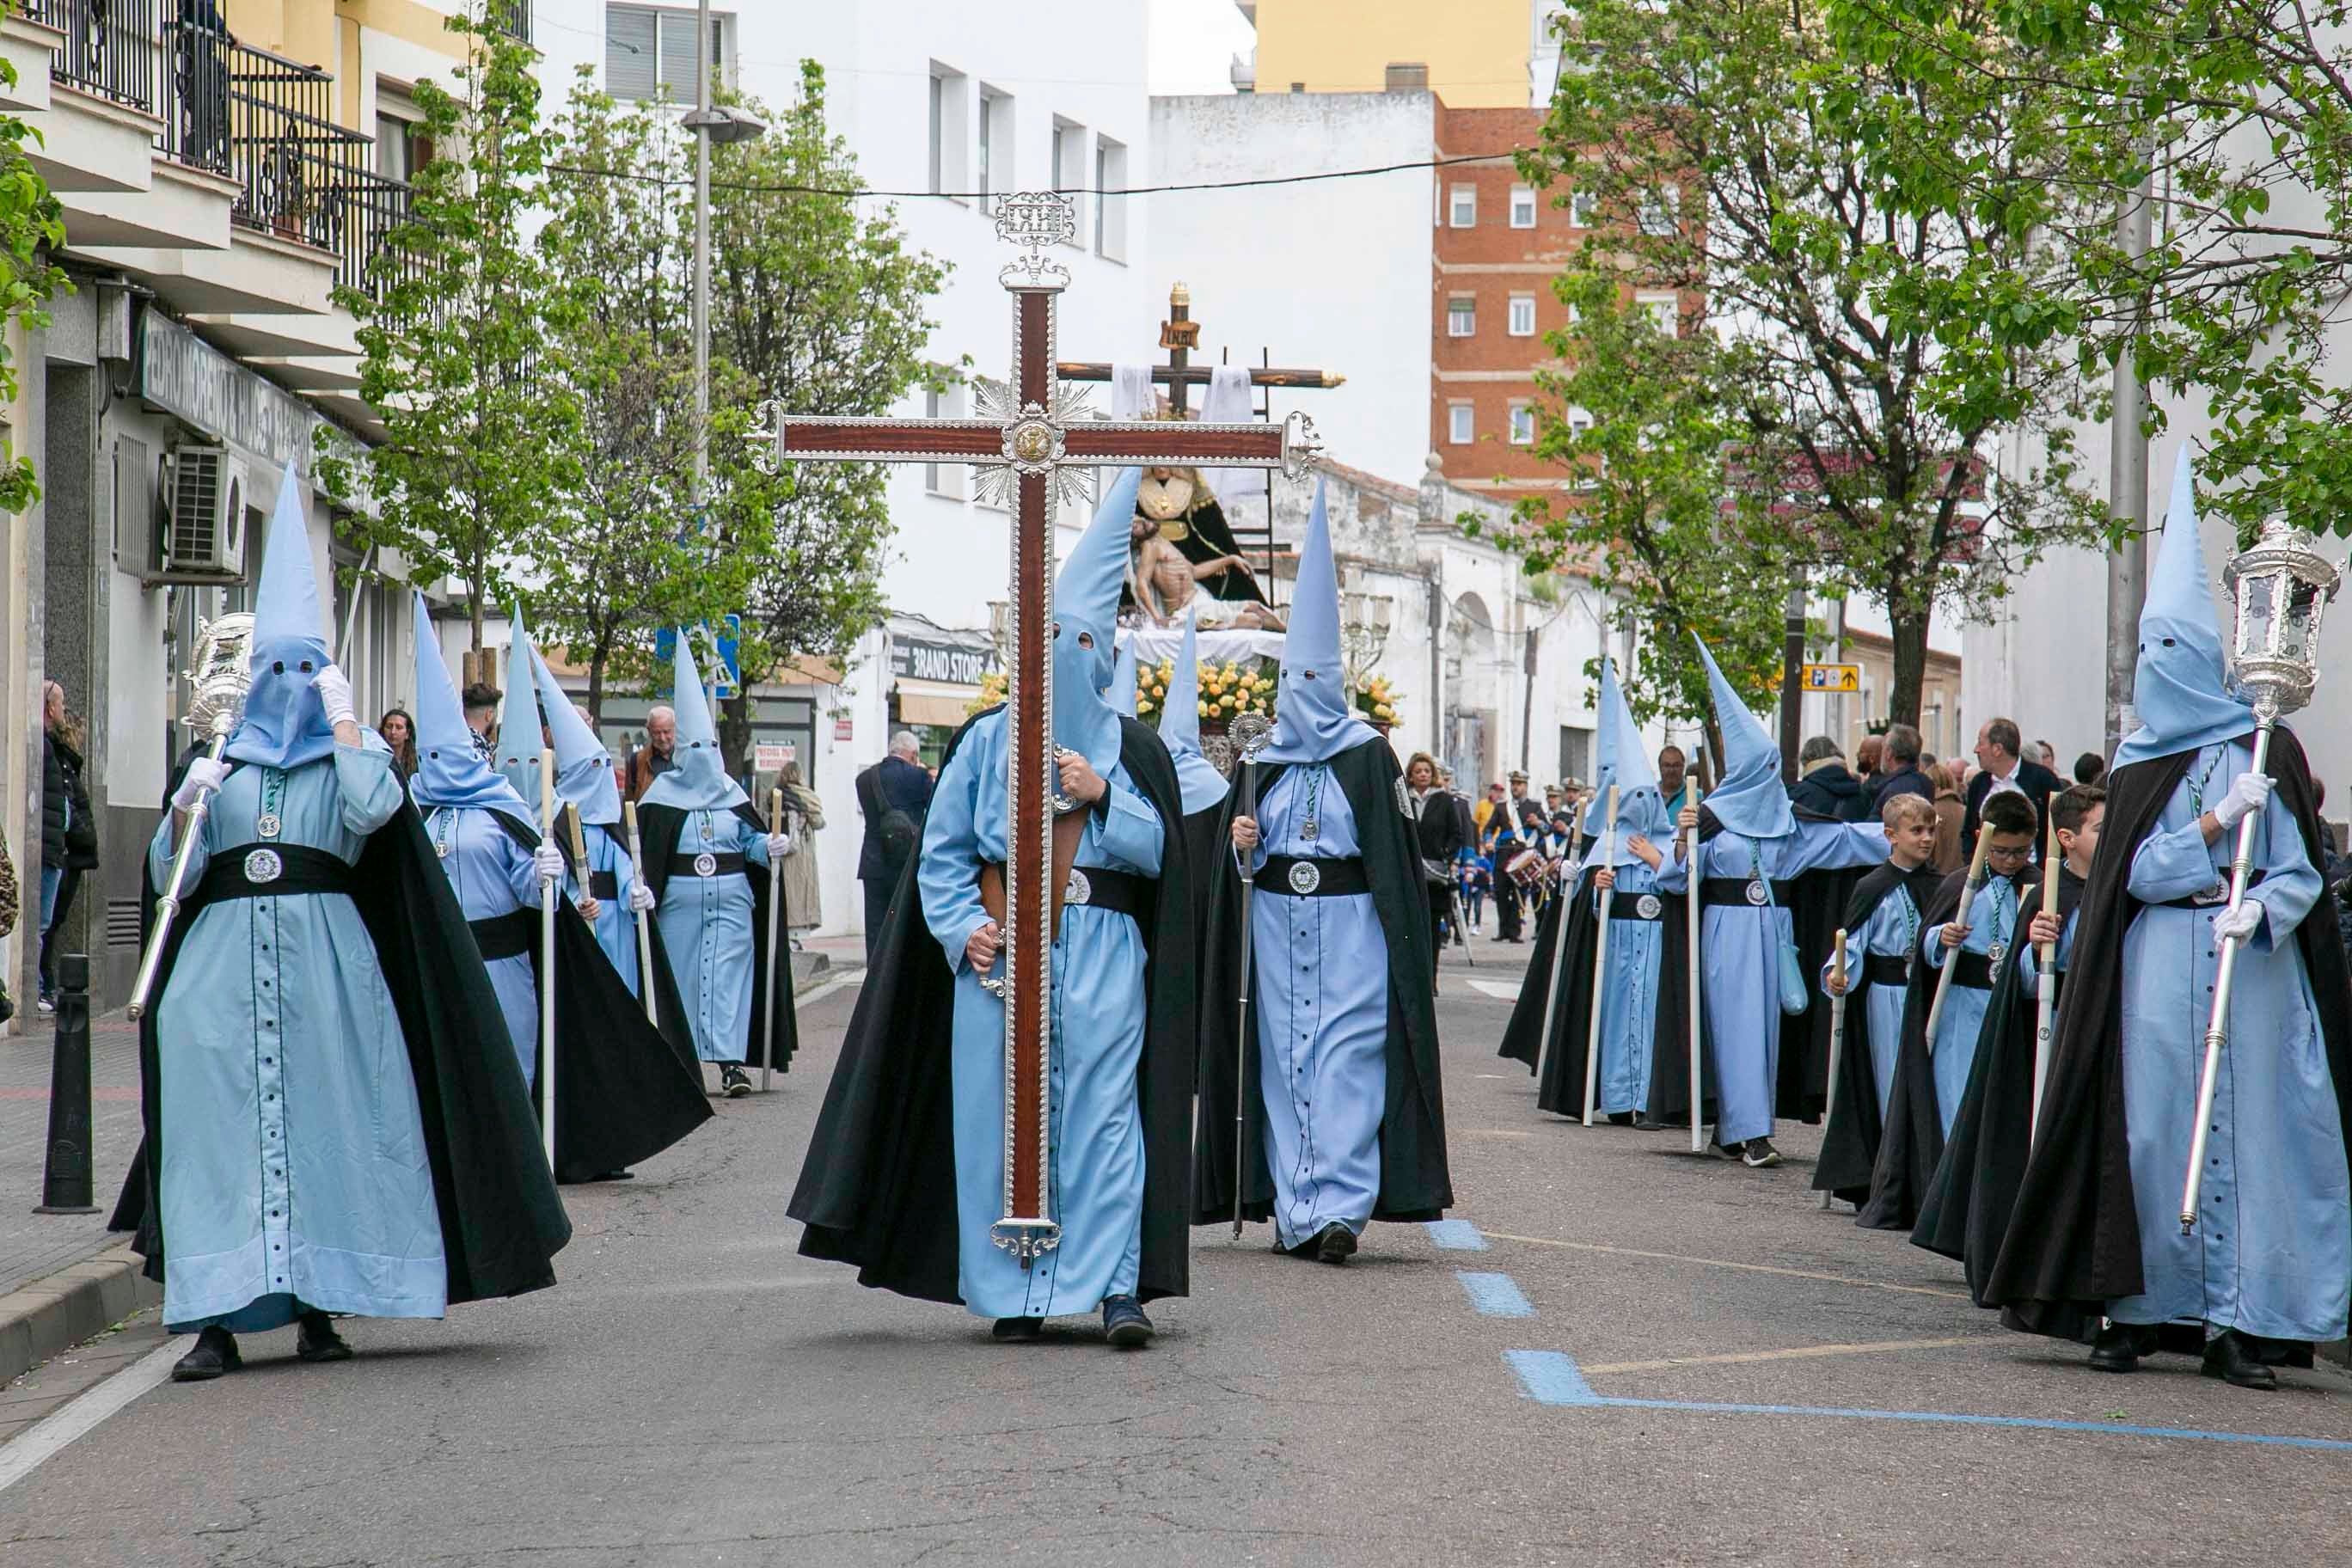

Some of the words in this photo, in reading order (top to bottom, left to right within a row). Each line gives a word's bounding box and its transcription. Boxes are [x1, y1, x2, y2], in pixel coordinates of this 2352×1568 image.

[146, 319, 181, 408] PEDRO
[182, 340, 227, 432] MORENO
[951, 652, 984, 684] STORE
